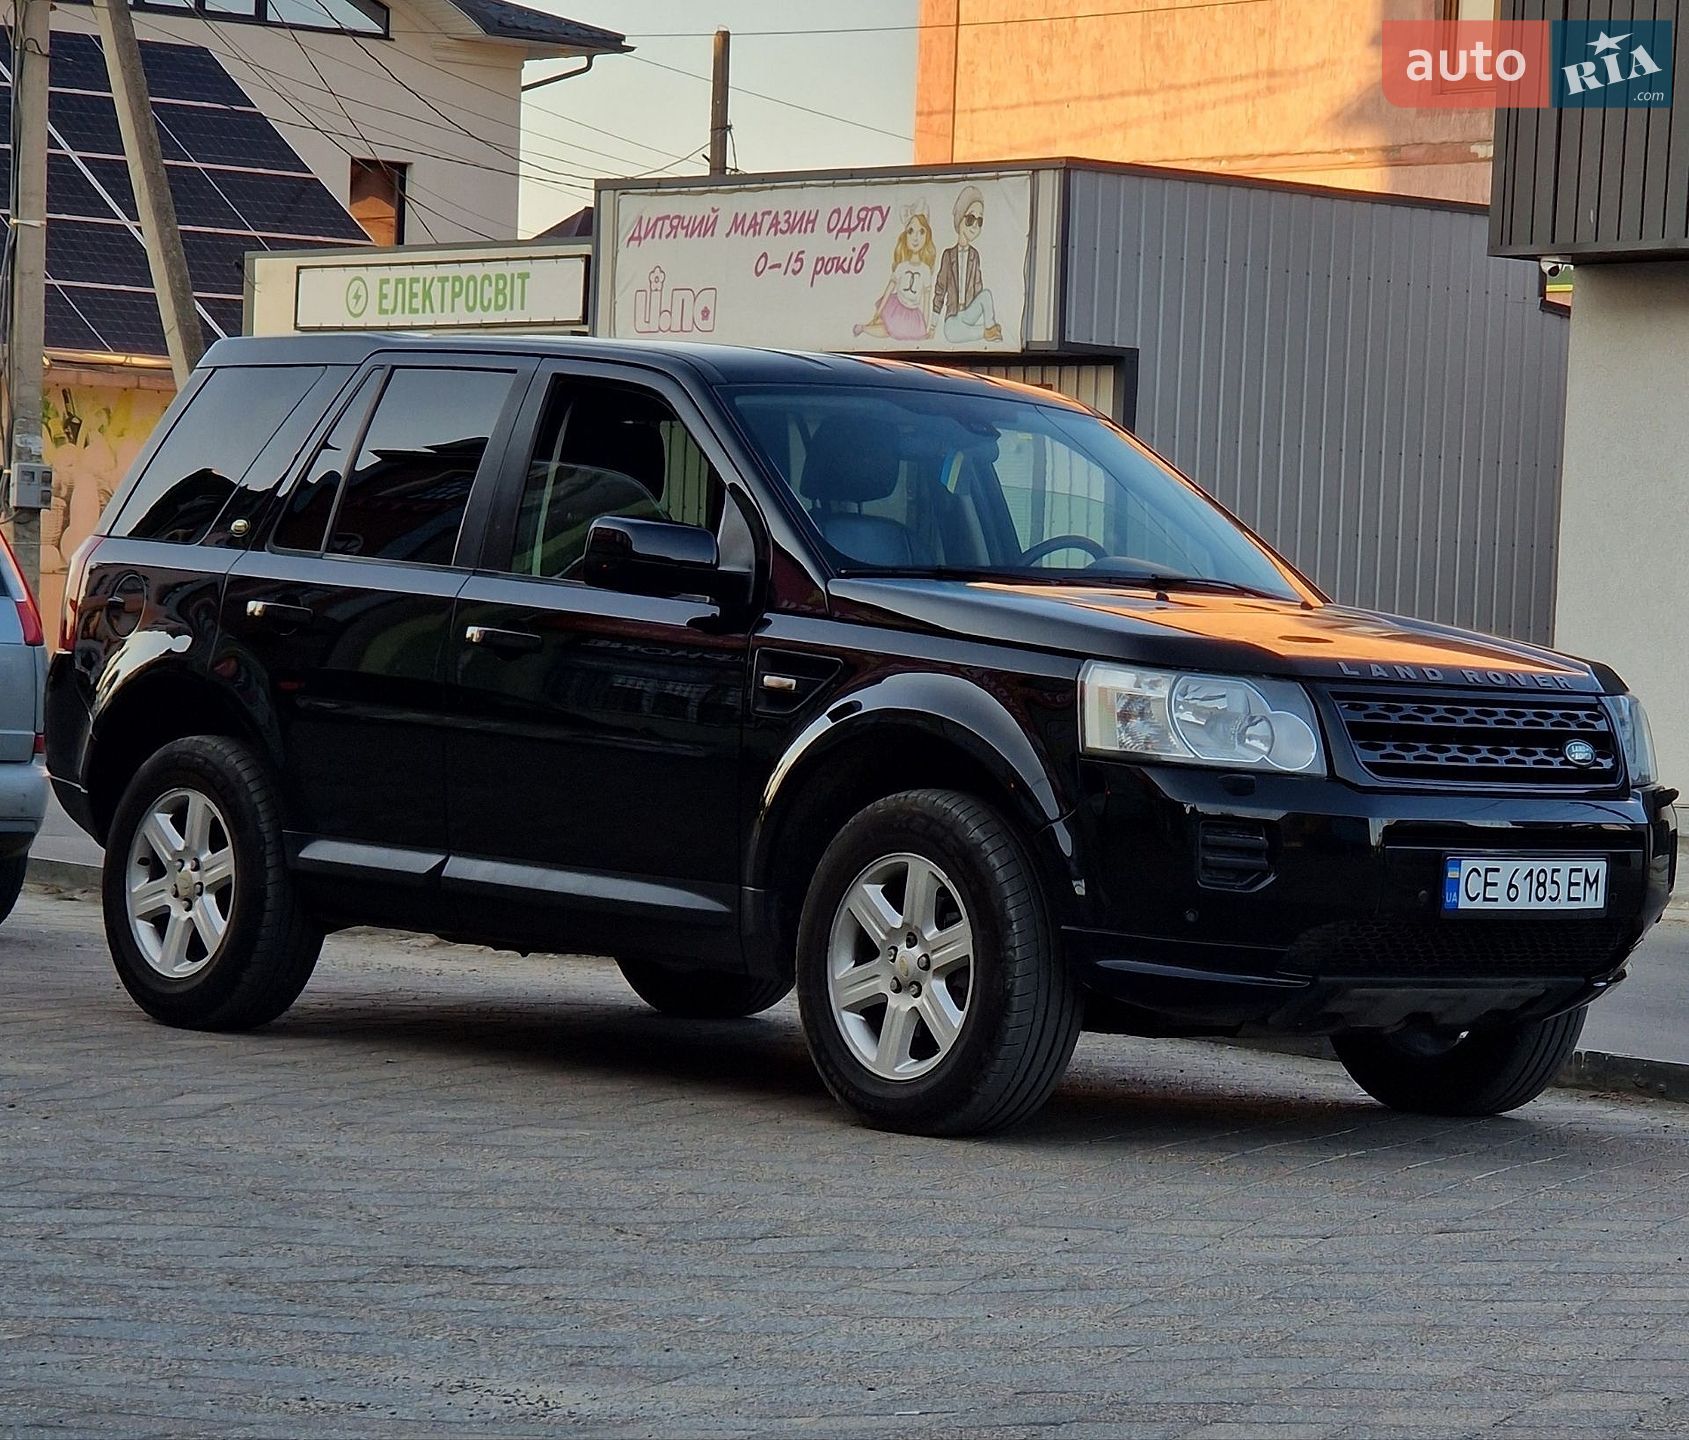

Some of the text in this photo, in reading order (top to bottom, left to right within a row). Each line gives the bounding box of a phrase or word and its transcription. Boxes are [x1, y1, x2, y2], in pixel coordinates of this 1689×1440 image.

[626, 205, 891, 248] ДИТЯЧИЙ МАГАЗИН ОДЯГУ
[754, 242, 870, 287] 0-15 років
[377, 271, 530, 316] ЕЛЕКТРОСВІТ
[1337, 661, 1574, 690] LAND ROVER
[1445, 891, 1458, 903] UA
[1464, 867, 1600, 902] CE 6185 EM
